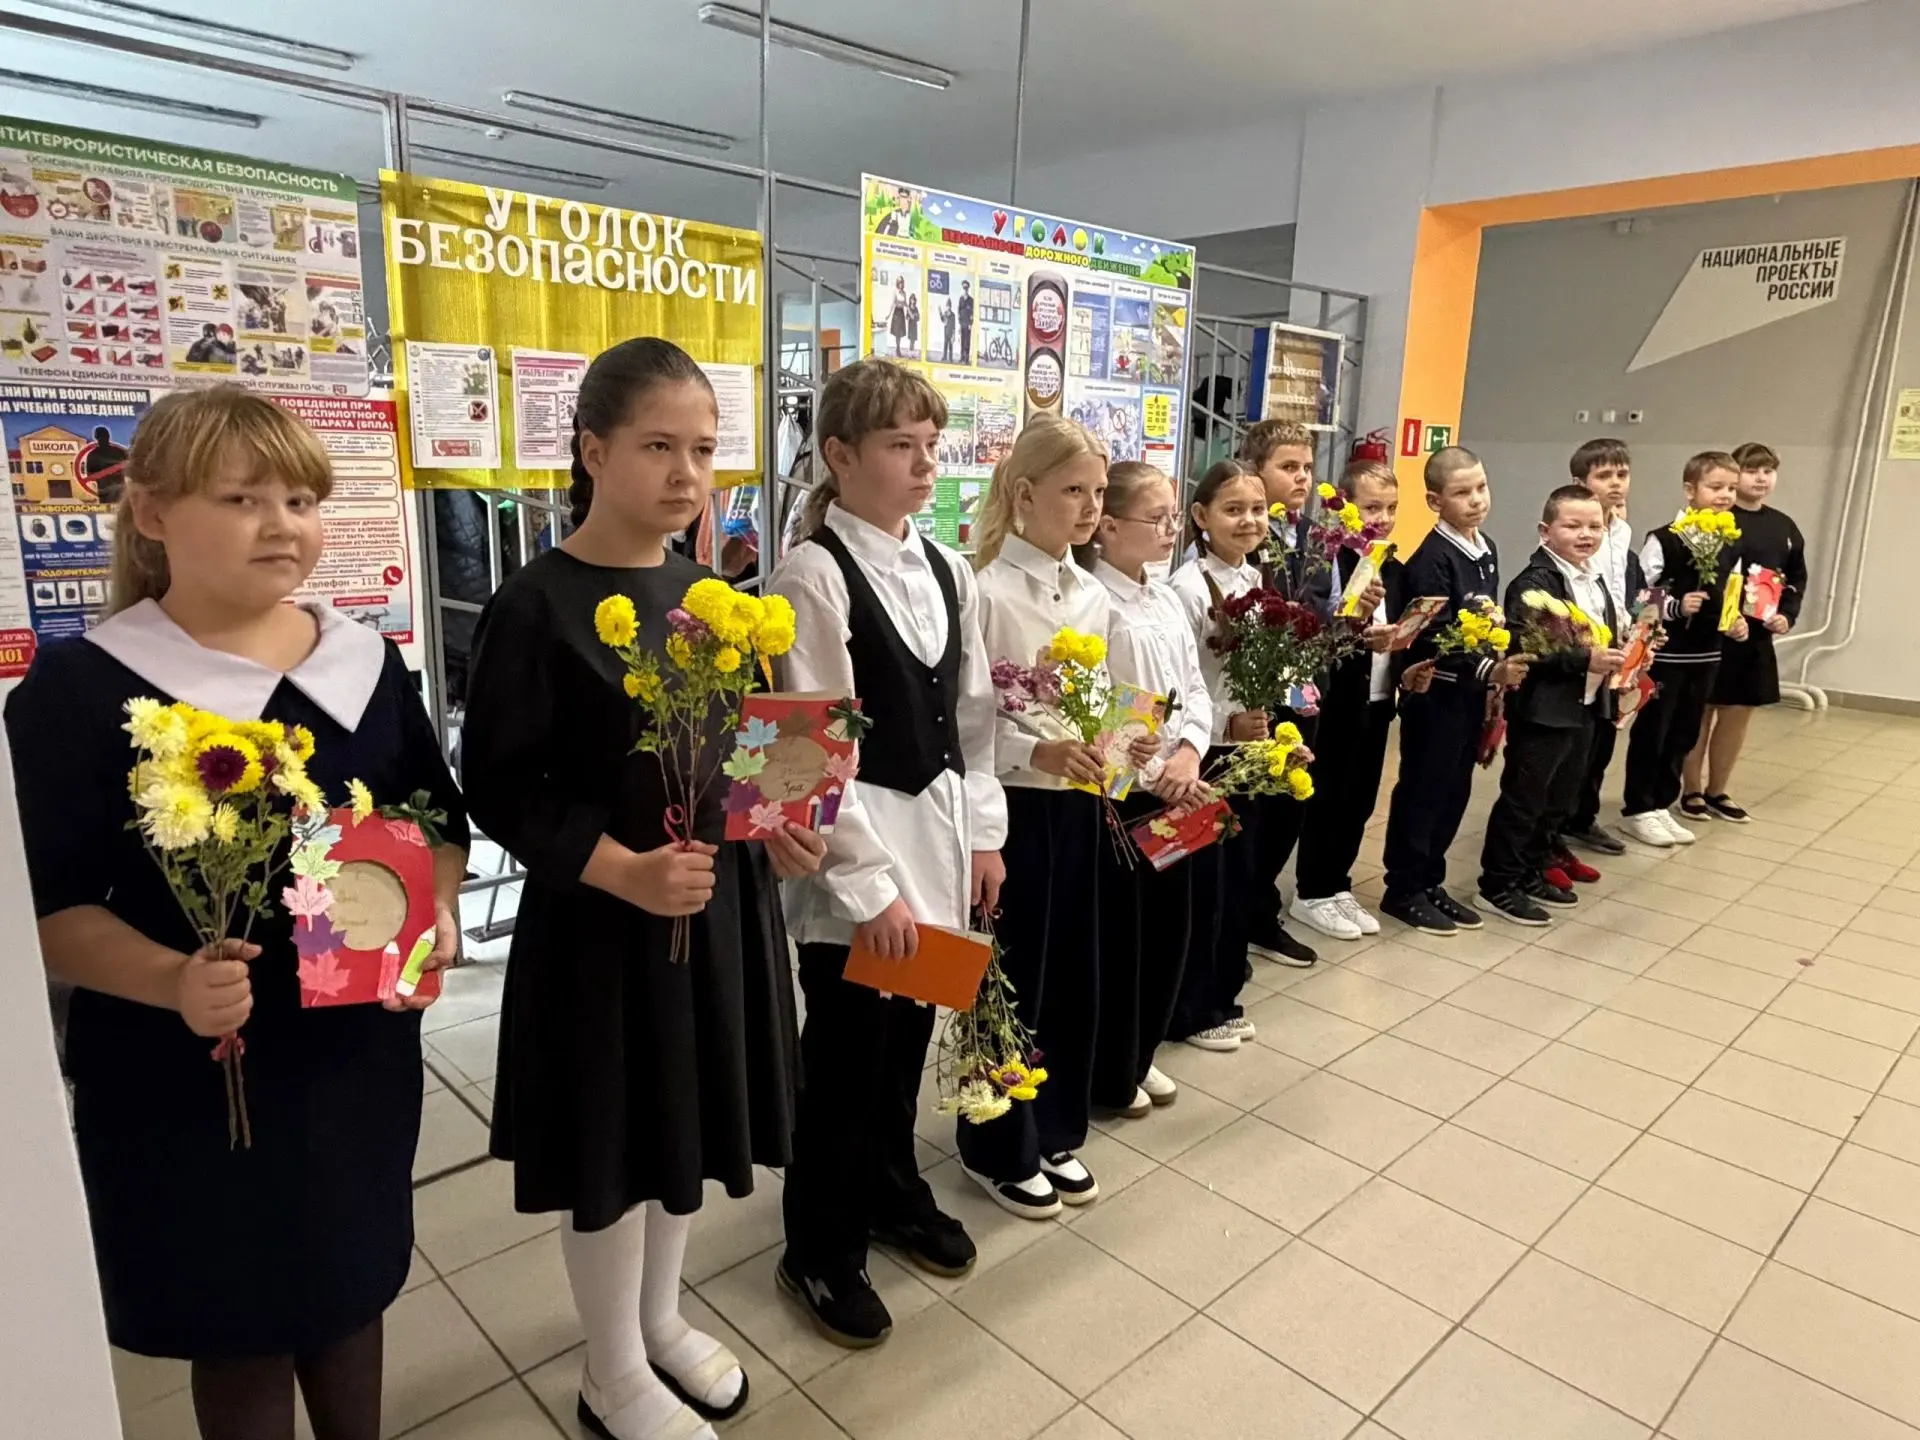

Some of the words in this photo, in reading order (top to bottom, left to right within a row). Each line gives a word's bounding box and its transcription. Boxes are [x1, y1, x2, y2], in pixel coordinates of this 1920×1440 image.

[0, 126, 213, 173] ТИТЕРРОРИСТИЧЕСКАЯ
[216, 161, 339, 193] БЕЗОПАСНОСТЬ
[245, 186, 304, 203] ТЕРРОРИЗМУ
[481, 186, 689, 259] УГОЛОК
[991, 209, 1105, 256] УГОЛОК
[50, 227, 83, 238] ВАШИ
[240, 251, 297, 265] СИТУАЦИЯХ
[1701, 240, 1841, 268] НАЦИОНАЛЬНЫЕ
[1025, 244, 1089, 267] ДОРОЖНОГО
[1089, 257, 1141, 278] ДВИЖЕНИЯ
[1756, 260, 1839, 283] ПРОЕКТЫ
[1767, 280, 1835, 301] РОССИИ
[18, 366, 70, 377] ТЕЛЕФОН
[72, 369, 118, 381] ЕДИНОЙ
[32, 386, 58, 399] ПРИ
[58, 387, 147, 402] ВООРУЖЁННОМ
[258, 381, 298, 391] СЛУЖБЫ
[12, 401, 67, 414] УЧЕБНОЕ
[69, 403, 136, 417] ЗАВЕДЕНИЕ
[280, 398, 348, 410] ПОВЕДЕНИЯ
[350, 401, 371, 410] ПРИ
[300, 408, 386, 419] БЕСПИЛОТНОГО
[304, 418, 354, 428] ППАРАТА
[357, 420, 394, 431] (БПЛА)
[32, 442, 75, 452] ШКОЛА
